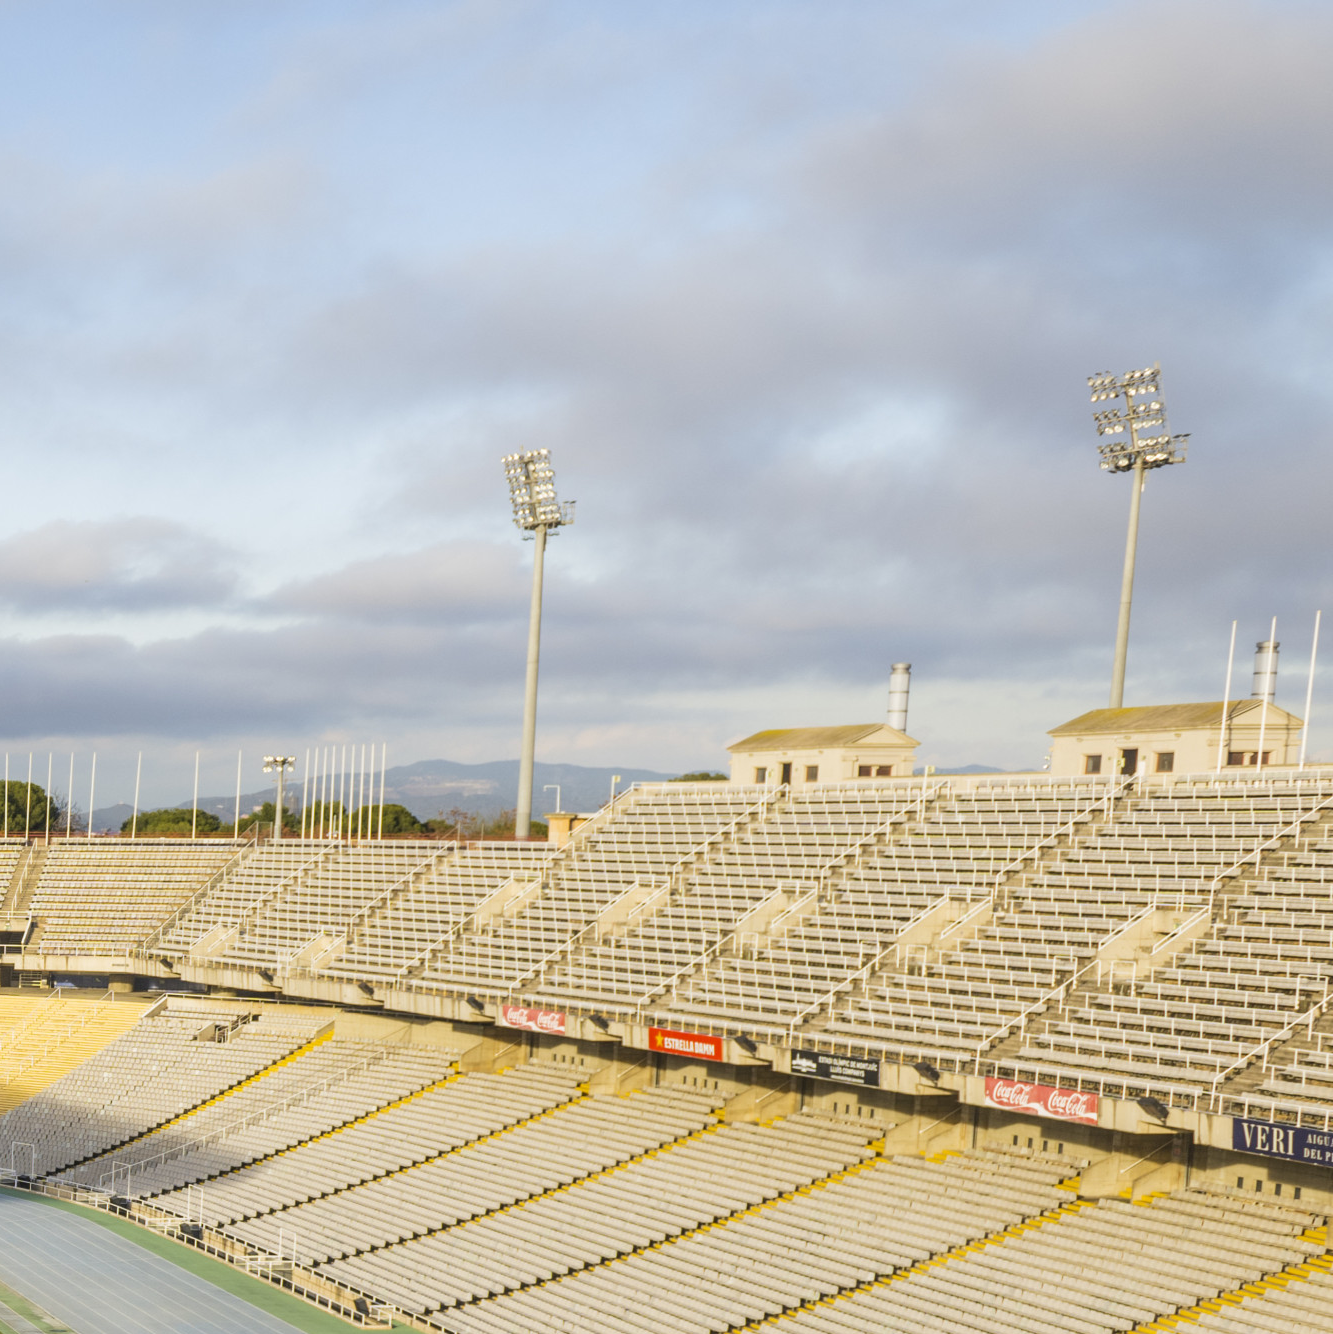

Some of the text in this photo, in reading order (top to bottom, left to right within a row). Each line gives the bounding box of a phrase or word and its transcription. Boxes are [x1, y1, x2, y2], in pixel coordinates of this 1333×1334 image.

[664, 1036, 715, 1056] ESTRELLA DAMM
[1241, 1123, 1295, 1155] VERI
[1303, 1147, 1323, 1160] DEL
